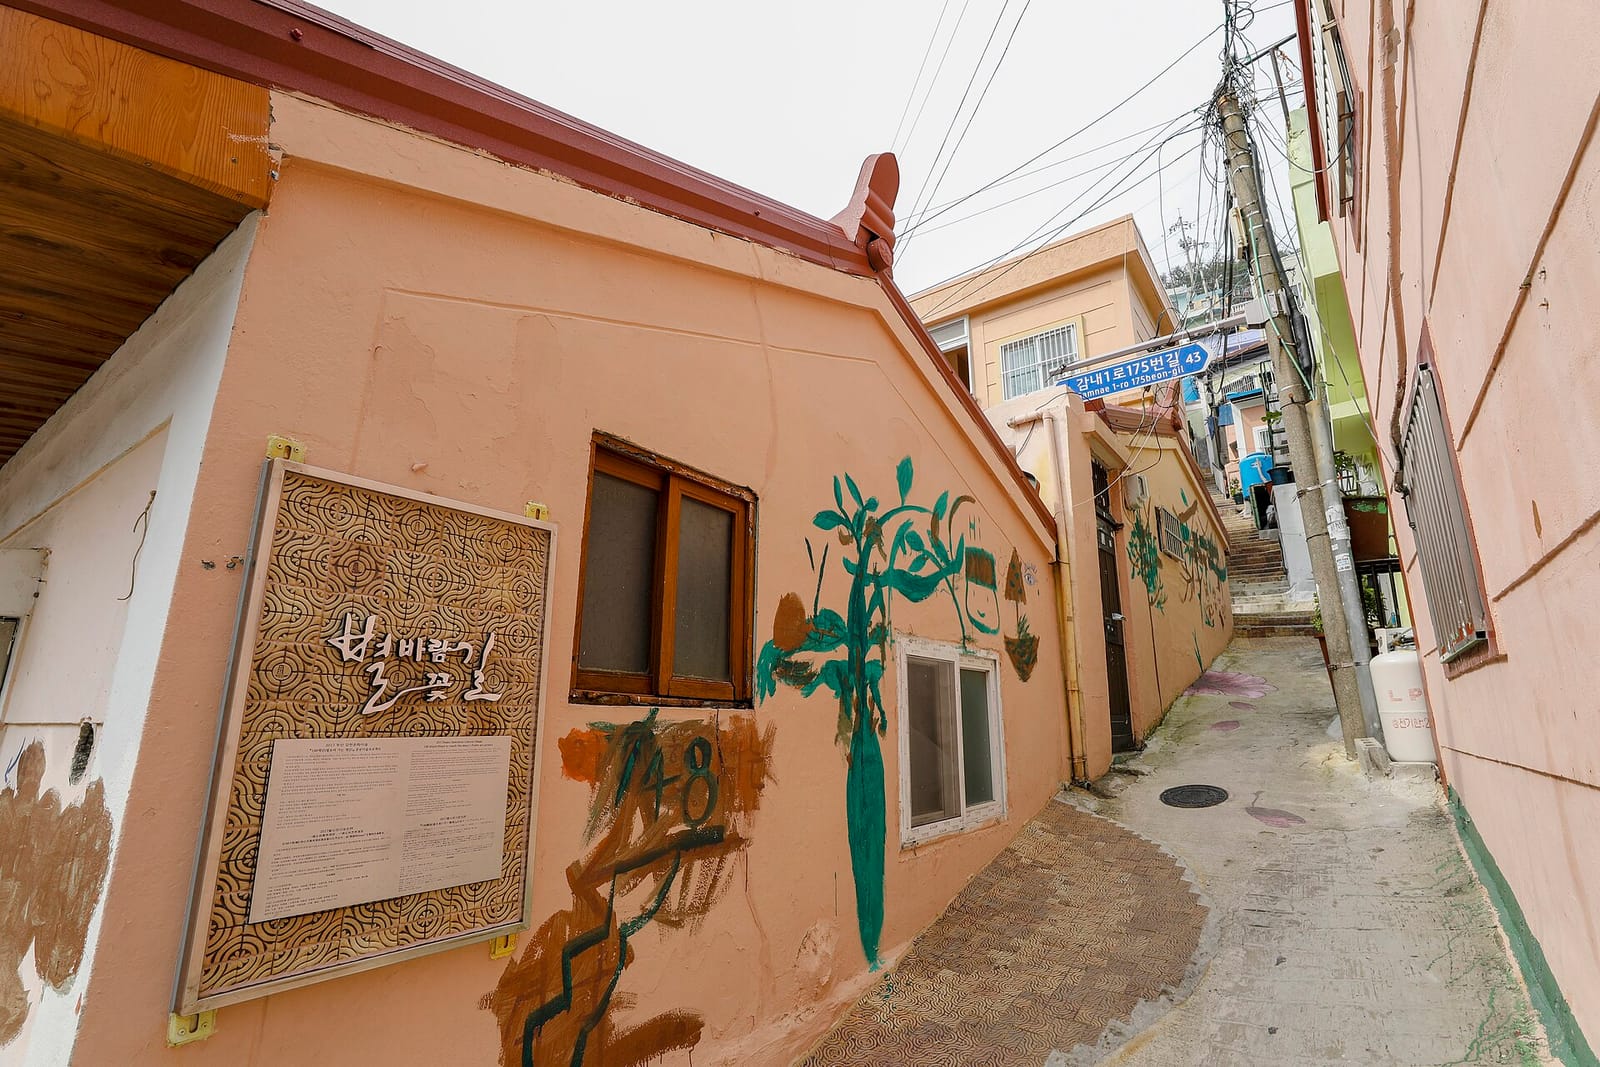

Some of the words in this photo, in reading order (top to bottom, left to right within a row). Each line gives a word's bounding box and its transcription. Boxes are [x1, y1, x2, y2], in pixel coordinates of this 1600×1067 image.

[1076, 351, 1181, 391] 감내1로175번길
[1186, 351, 1202, 364] 43
[1082, 386, 1110, 398] amnae
[1112, 381, 1129, 390] 1-ro
[1131, 365, 1185, 385] 175beon-gil
